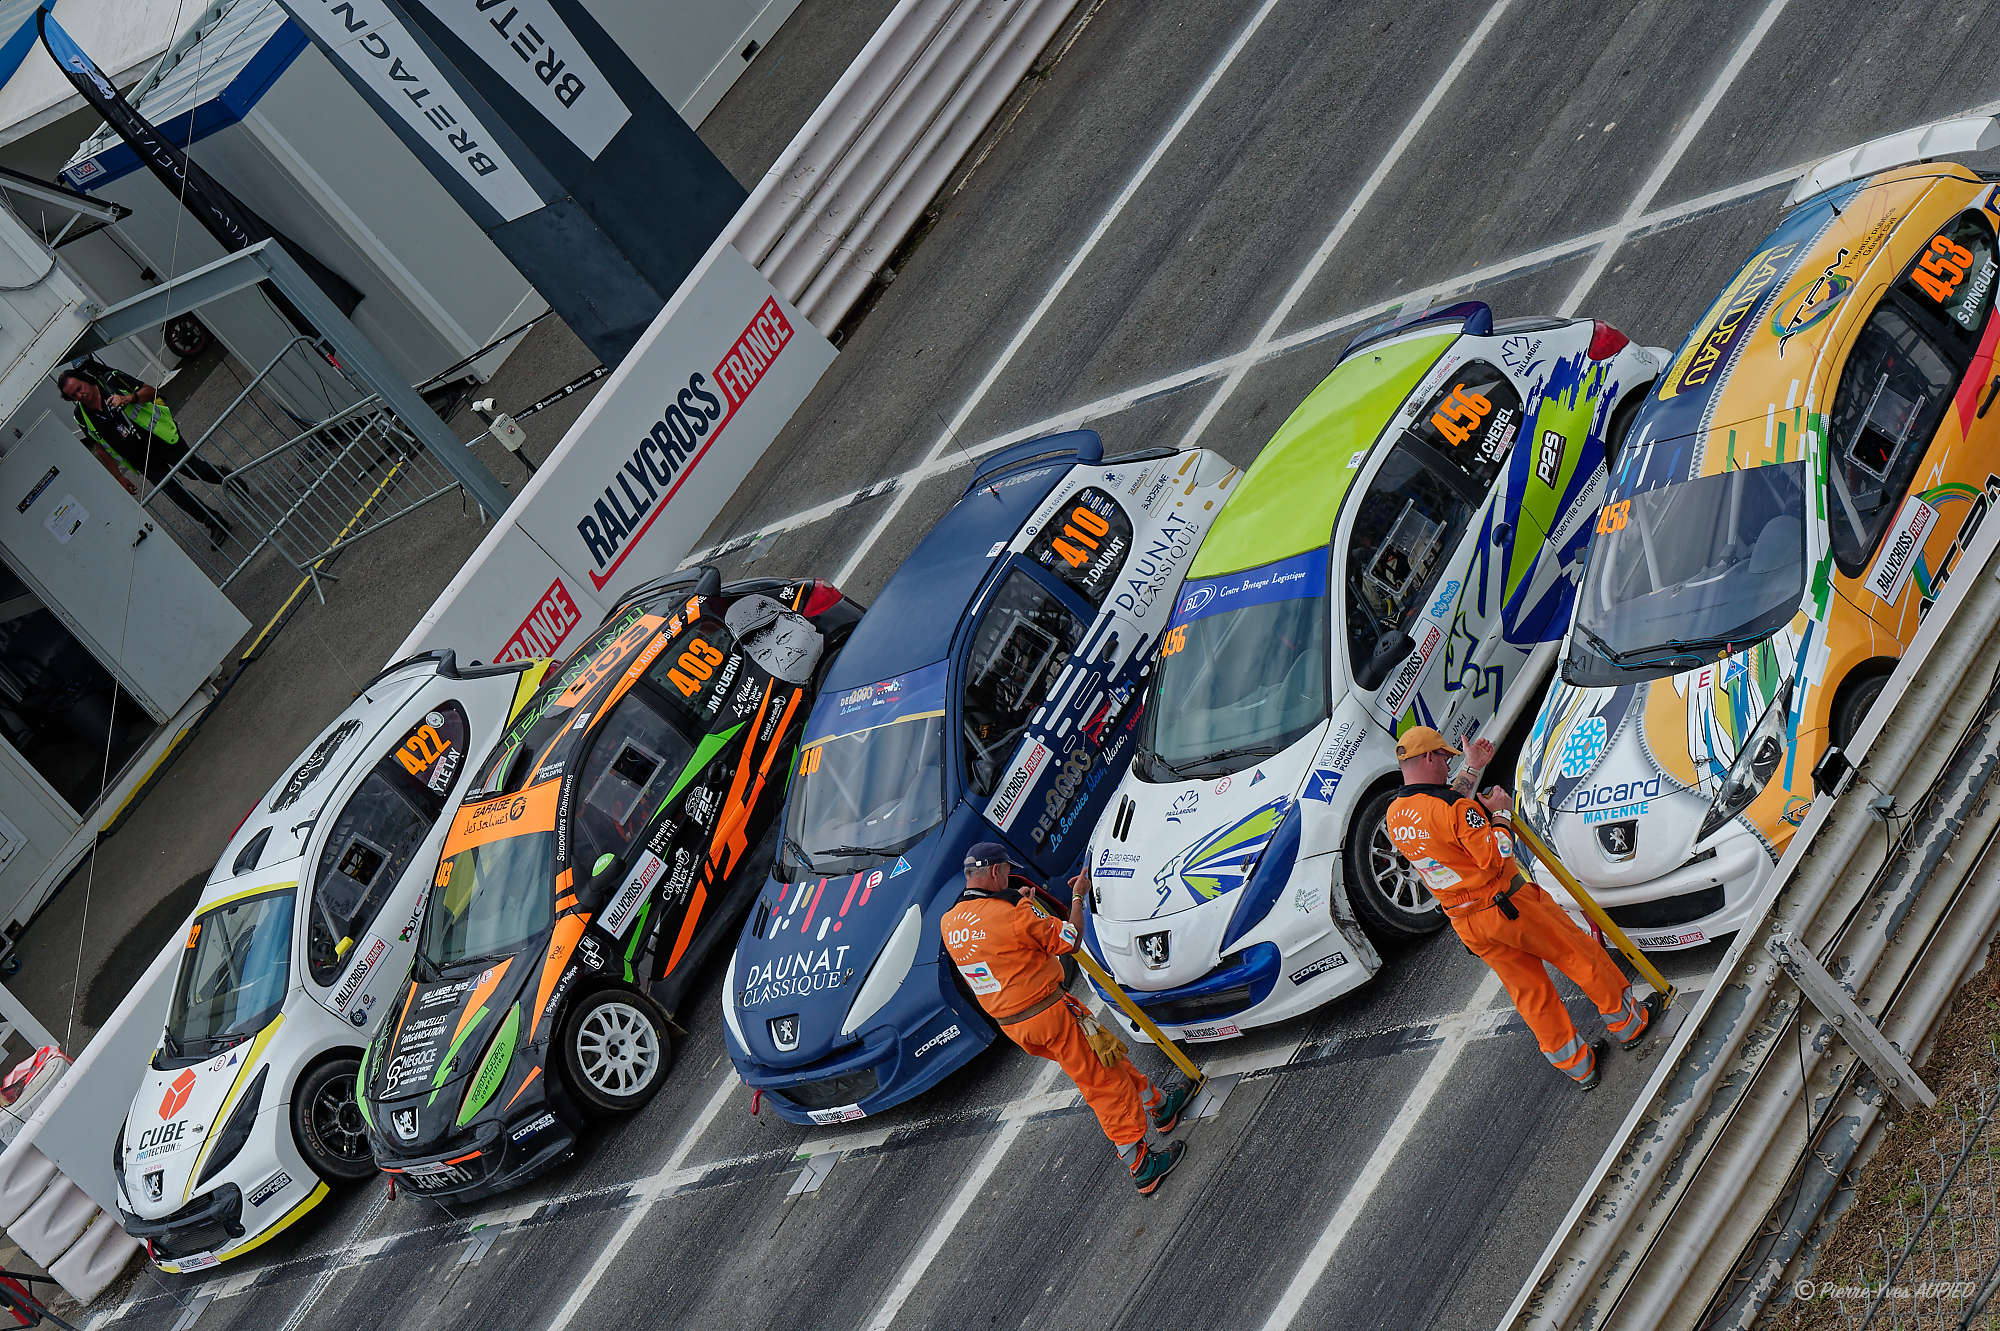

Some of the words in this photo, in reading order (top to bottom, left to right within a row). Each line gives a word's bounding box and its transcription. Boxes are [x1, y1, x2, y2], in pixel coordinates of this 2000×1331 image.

[1910, 235, 1975, 304] 453
[1777, 248, 1849, 360] ATPM
[1957, 257, 2000, 325] S.RINGUET
[1684, 249, 1789, 387] LANDEAU
[1512, 338, 1542, 378] PAILLARDON
[1430, 382, 1493, 447] 456
[577, 372, 721, 569] RALLYCROSS
[720, 302, 790, 403] FRANCE
[1475, 406, 1515, 465] Y.CHEREL
[1535, 431, 1559, 482] P2S
[1597, 499, 1631, 535] 453
[1051, 506, 1110, 569] 410
[1876, 535, 1914, 595] RALLYCROSS
[1910, 504, 1931, 538] FRANCE
[1083, 534, 1125, 589] T.DAUNAT
[1115, 512, 1186, 612] DAUNAT
[1133, 521, 1200, 619] CLASSIQUE
[1218, 584, 1240, 597] Centre
[1240, 575, 1270, 591] Bretagne
[1270, 568, 1307, 584] Logistique
[639, 616, 683, 668] AUTOMOBILES
[1161, 624, 1186, 657] 456
[666, 638, 724, 699] 403
[713, 652, 742, 695] GUERIN
[1386, 653, 1424, 714] RALLYCROSS
[1420, 624, 1442, 662] FRANCE
[705, 693, 722, 713] JM
[731, 701, 744, 717] Le
[1449, 713, 1468, 735] JMH
[395, 724, 451, 776] 422
[444, 747, 460, 769] LAY
[799, 745, 822, 777] 410
[1320, 721, 1350, 767] RUELLAND
[1331, 739, 1352, 769] LOUDÉAC
[1338, 728, 1368, 771] PLOUGUENAST
[990, 765, 1030, 821] RALLYCROSS
[1024, 744, 1046, 774] FRANCE
[1044, 831, 1063, 853] Le
[1056, 790, 1090, 834] Service
[1098, 730, 1129, 765] blanc,
[1319, 777, 1338, 800] AXA
[1576, 773, 1662, 812] picard
[472, 799, 512, 819] GARAGE
[1583, 802, 1649, 824] MAYENNE
[556, 815, 569, 862] Supporters
[647, 818, 671, 849] Hamelin
[654, 823, 678, 853] MAIRIE
[1393, 826, 1416, 841] 100
[435, 861, 454, 887] 403
[660, 853, 685, 901] Comptoir
[608, 878, 643, 929] RALLYCROSS
[641, 857, 660, 886] FRANCE
[948, 928, 970, 946] 100
[1638, 935, 1678, 948] RALLYCROSS
[1680, 932, 1704, 944] FRANCE
[334, 960, 368, 1008] RALLYCROSS
[367, 940, 384, 967] FRANCE
[561, 964, 578, 983] Philippe
[745, 945, 850, 990] DAUNAT
[1291, 953, 1341, 984] COOPER
[1319, 959, 1345, 974] TIRES
[743, 971, 841, 1008] CLASSIQUE
[914, 1024, 958, 1058] COOPER
[938, 1029, 961, 1047] TIRES
[1184, 1028, 1218, 1039] RALLYCROSS
[1218, 1025, 1238, 1036] FRANCE
[401, 1048, 437, 1068] NEGOCE
[138, 1120, 188, 1150] CUBE
[511, 1112, 553, 1141] COOPER
[533, 1117, 555, 1132] TIRES
[135, 1144, 177, 1161] PROTECTION
[250, 1171, 288, 1204] COOPER
[270, 1177, 290, 1194] TIRES
